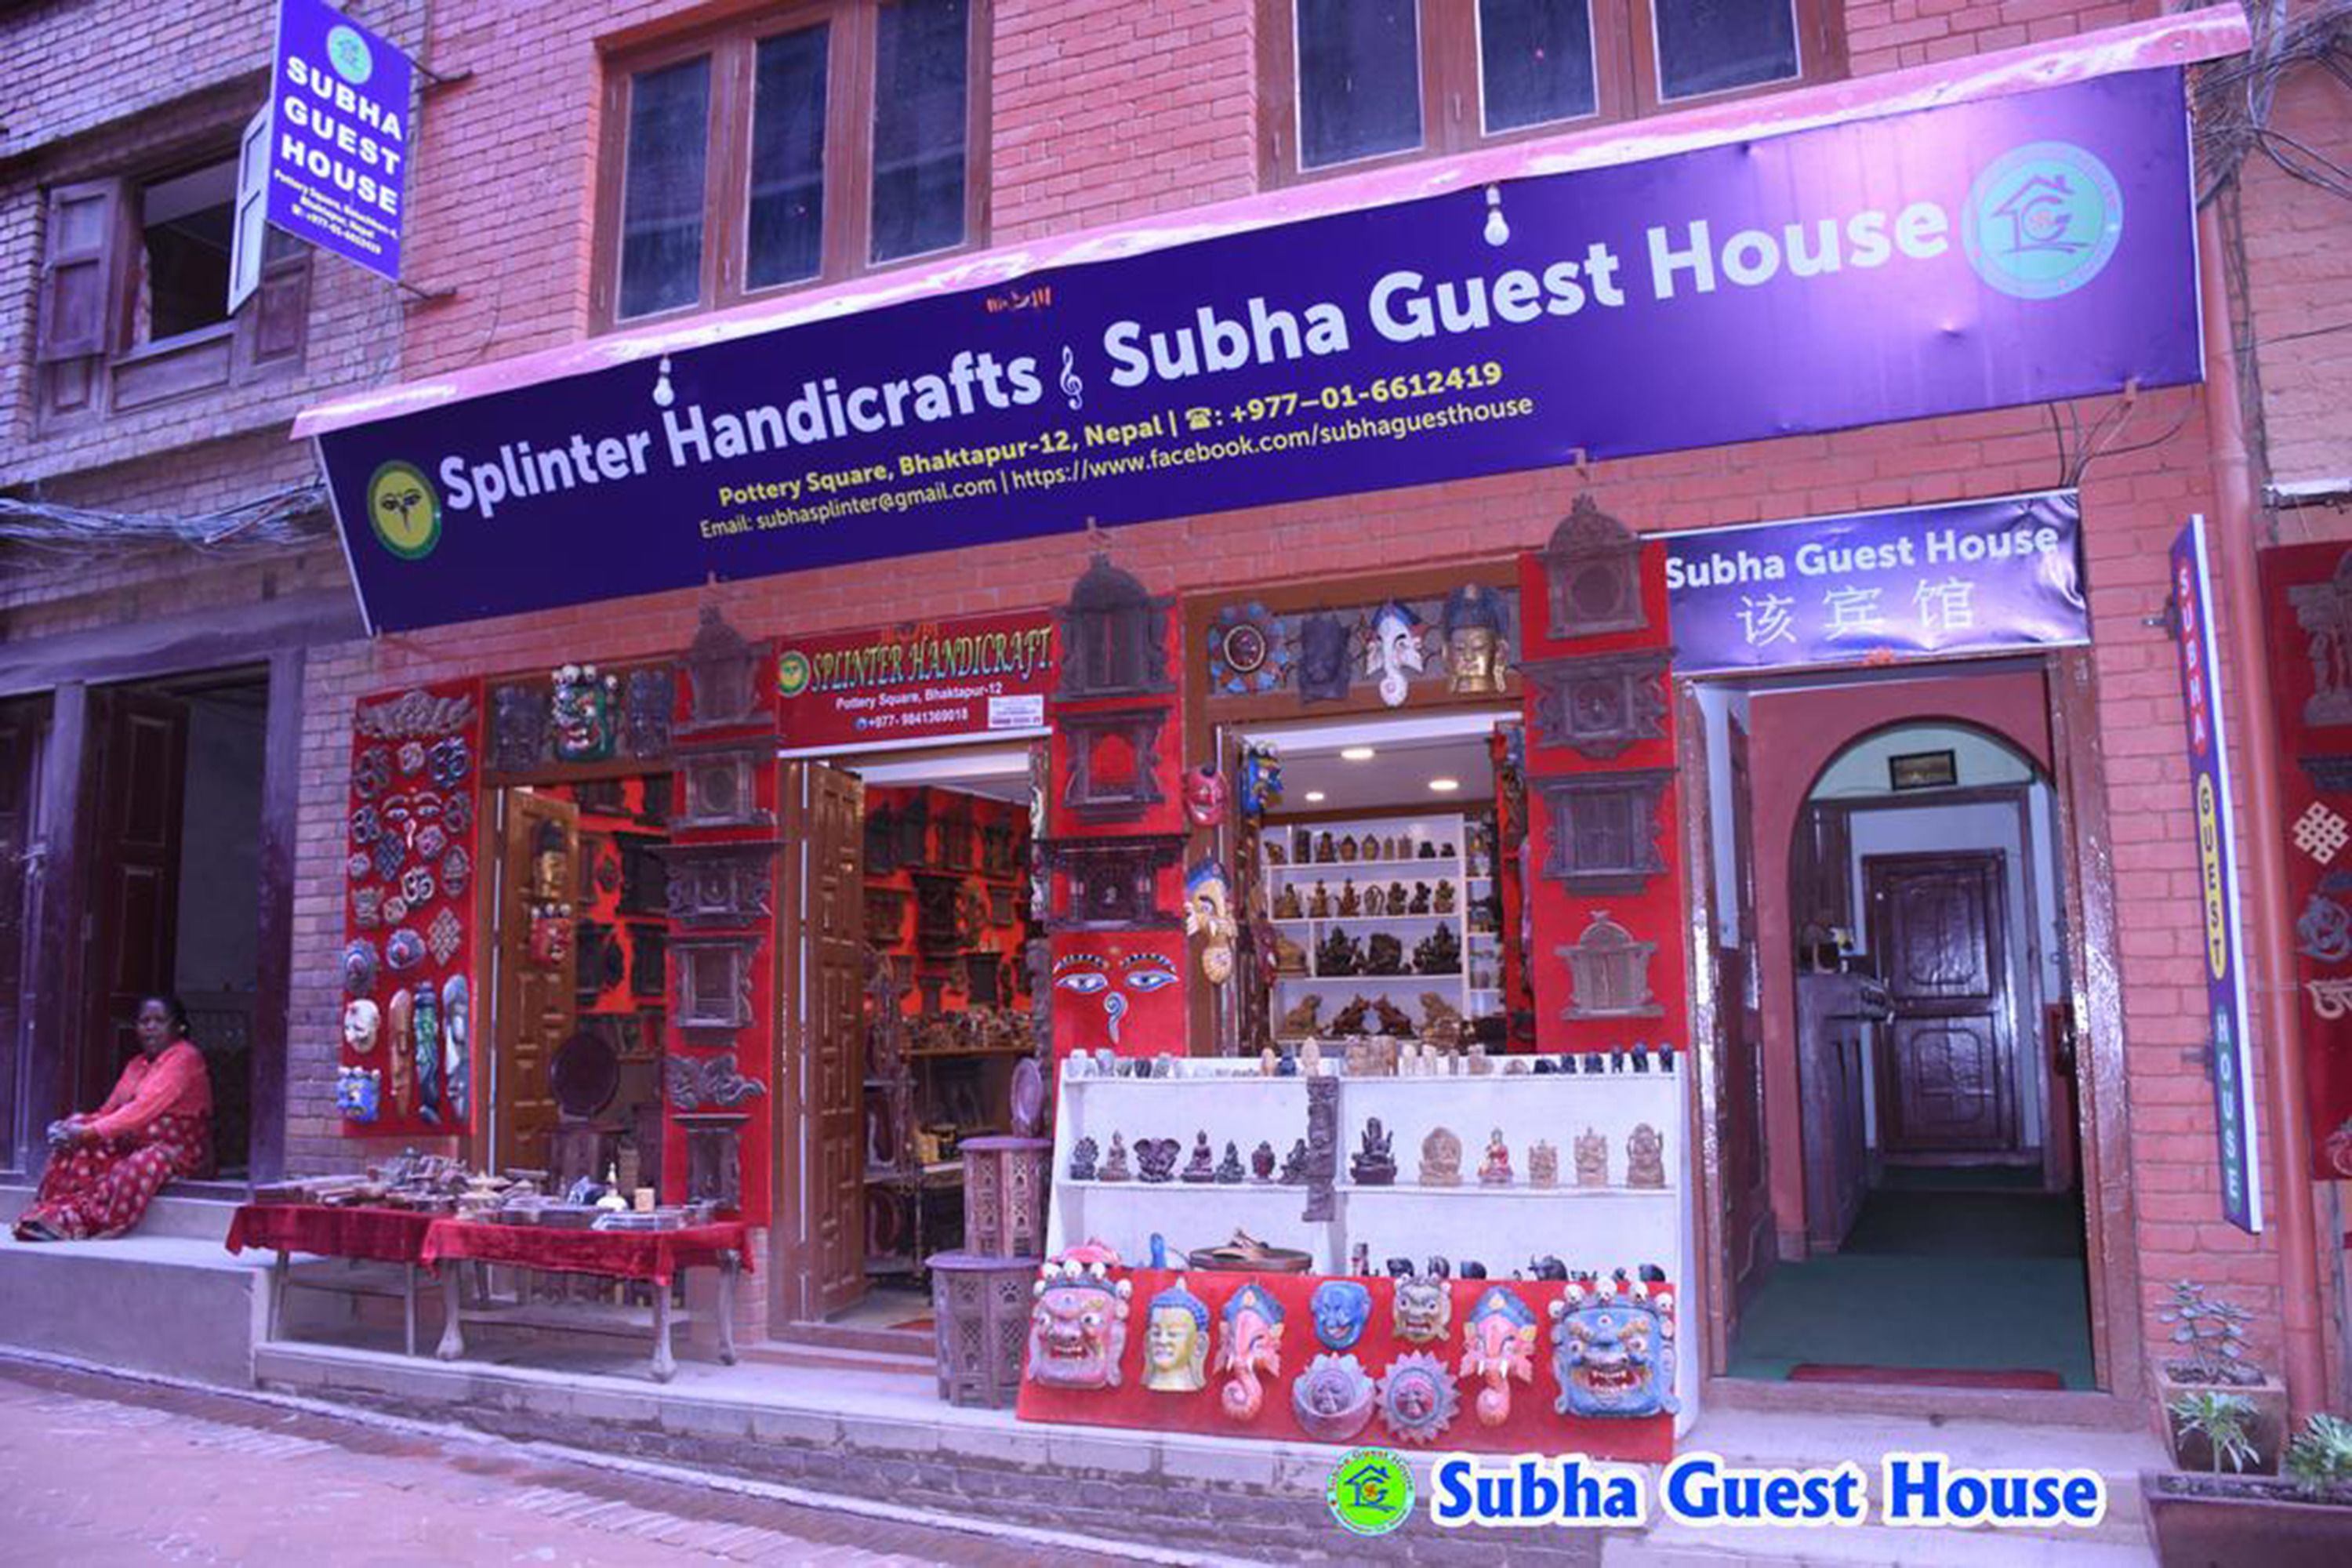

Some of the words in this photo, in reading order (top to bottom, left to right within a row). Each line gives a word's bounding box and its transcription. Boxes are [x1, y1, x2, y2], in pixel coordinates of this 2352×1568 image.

[285, 96, 401, 175] GUEST
[287, 56, 402, 141] SUBHA
[281, 134, 398, 216] HOUSE
[440, 428, 651, 518] Splinter
[662, 350, 1043, 468] Handicrafts
[1103, 297, 1350, 387] Subha
[1369, 242, 1625, 343] Guest
[1647, 201, 1950, 299] House
[700, 515, 754, 539] Email:
[757, 475, 996, 530] subhasplinter@gmail.com
[1012, 397, 1534, 491] https://www.facebook.com/subhaguesthouse
[718, 479, 801, 506] Pottery
[807, 466, 895, 493] Square,
[898, 431, 1080, 477] Bhaktapur-12,
[1083, 413, 1163, 448] Nepal
[1666, 552, 1785, 588] Subha
[1795, 540, 1915, 575] Guest
[1927, 527, 2060, 564] House
[811, 643, 904, 691] SPLINTER
[2179, 566, 2205, 746] SUBHA
[2201, 786, 2222, 967] GUEST
[2216, 1014, 2239, 1198] HOUSE
